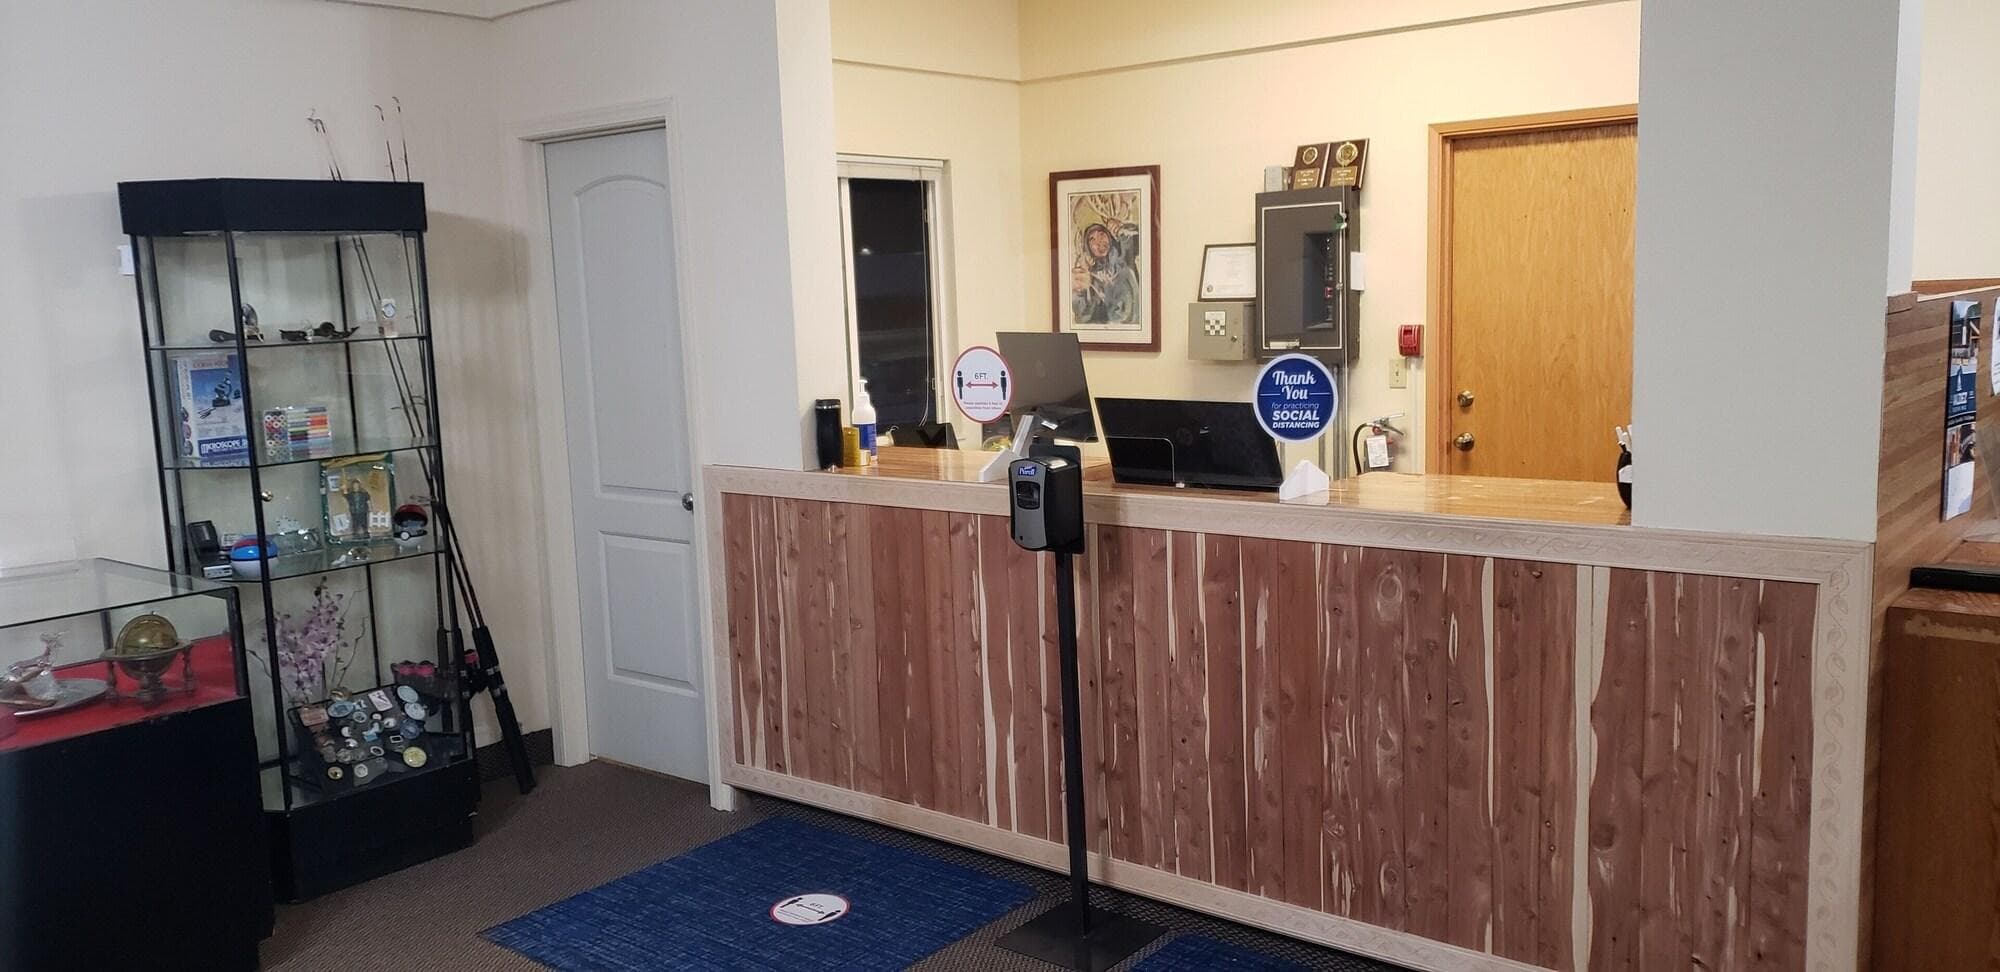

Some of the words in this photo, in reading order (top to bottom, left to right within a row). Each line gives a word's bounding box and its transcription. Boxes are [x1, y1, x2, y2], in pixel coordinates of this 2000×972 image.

[1272, 370, 1316, 385] Thank
[1281, 386, 1308, 400] You
[1283, 402, 1319, 410] practicing
[1272, 410, 1320, 421] SOCIAL
[1272, 421, 1320, 429] DISTANCING
